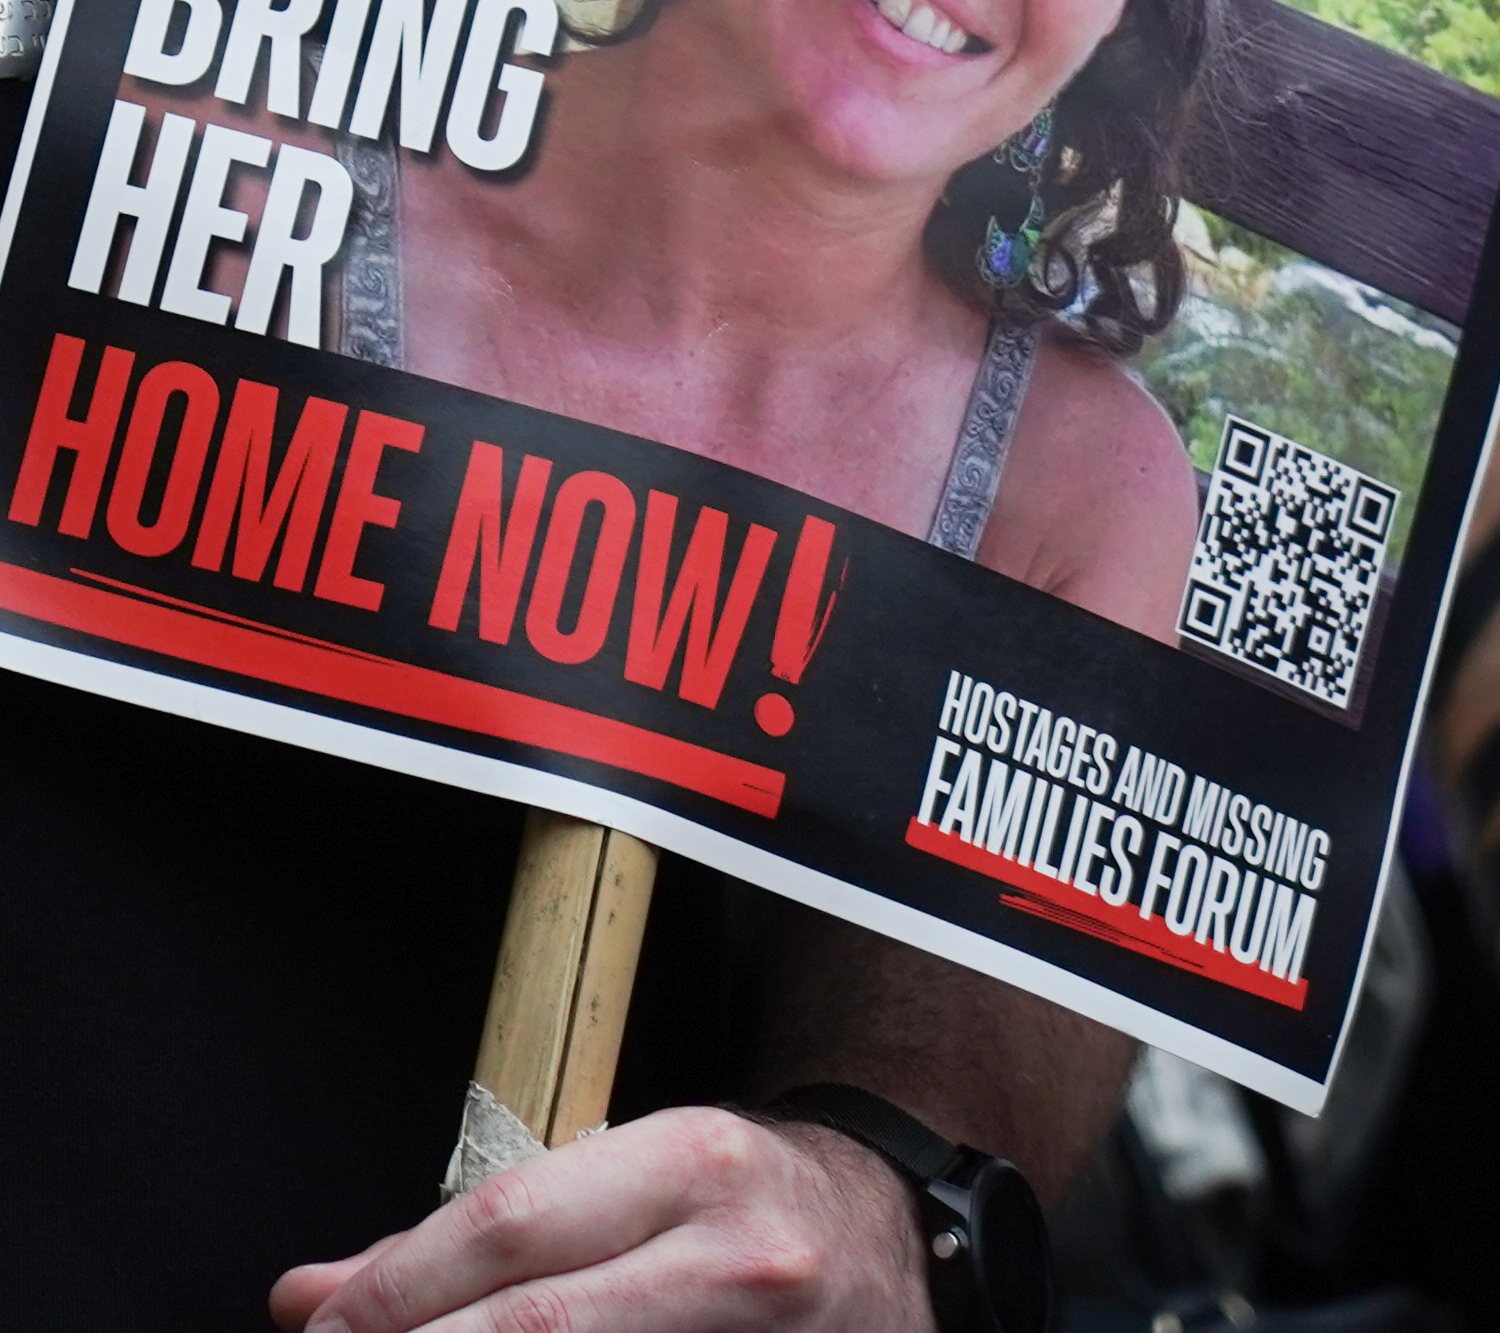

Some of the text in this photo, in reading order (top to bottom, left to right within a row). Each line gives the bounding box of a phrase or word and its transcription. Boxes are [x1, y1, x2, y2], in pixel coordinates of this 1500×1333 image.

[66, 99, 355, 350] HER
[7, 332, 850, 739] HOME NOW!
[916, 735, 1319, 986] FAMILIES FORUM
[937, 668, 1332, 890] HOSTAGES AND MISSING
